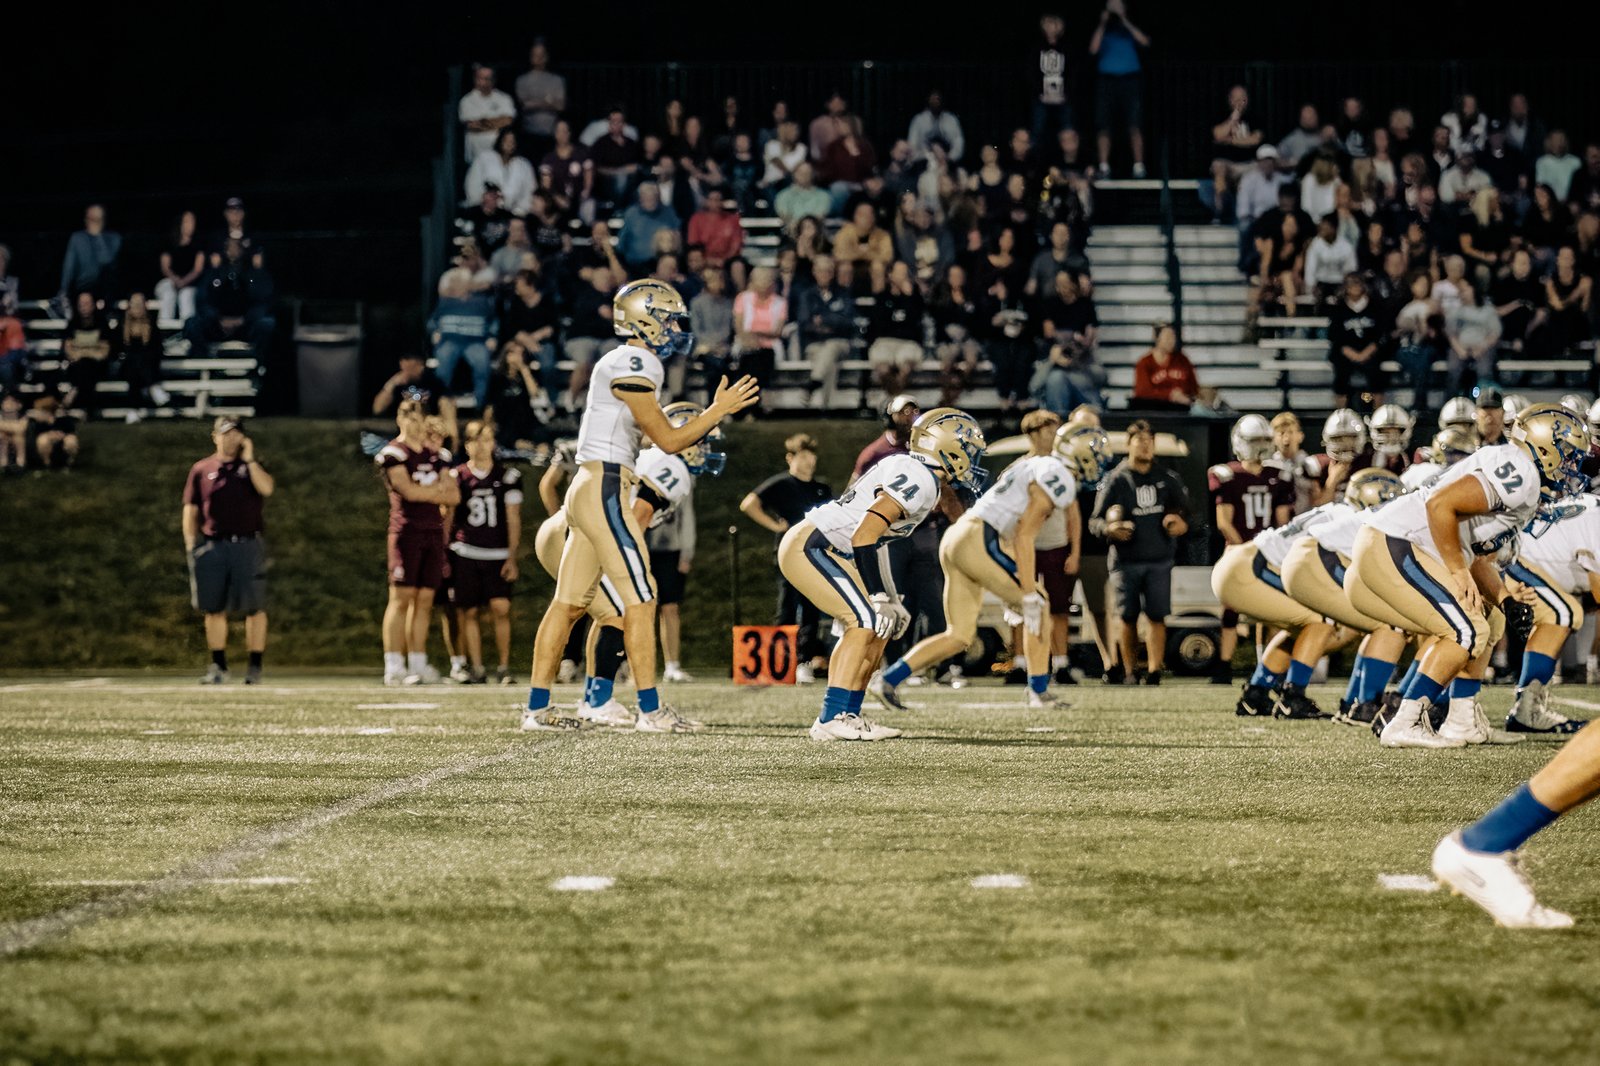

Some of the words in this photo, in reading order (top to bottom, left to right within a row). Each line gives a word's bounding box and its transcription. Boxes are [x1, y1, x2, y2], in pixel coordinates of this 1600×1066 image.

[629, 356, 644, 372] 3
[656, 467, 680, 492] 21
[888, 473, 920, 502] 24
[1045, 475, 1066, 497] 28
[1494, 461, 1524, 495] 52
[467, 495, 498, 528] 31
[1242, 492, 1272, 530] 14
[741, 631, 790, 681] 30
